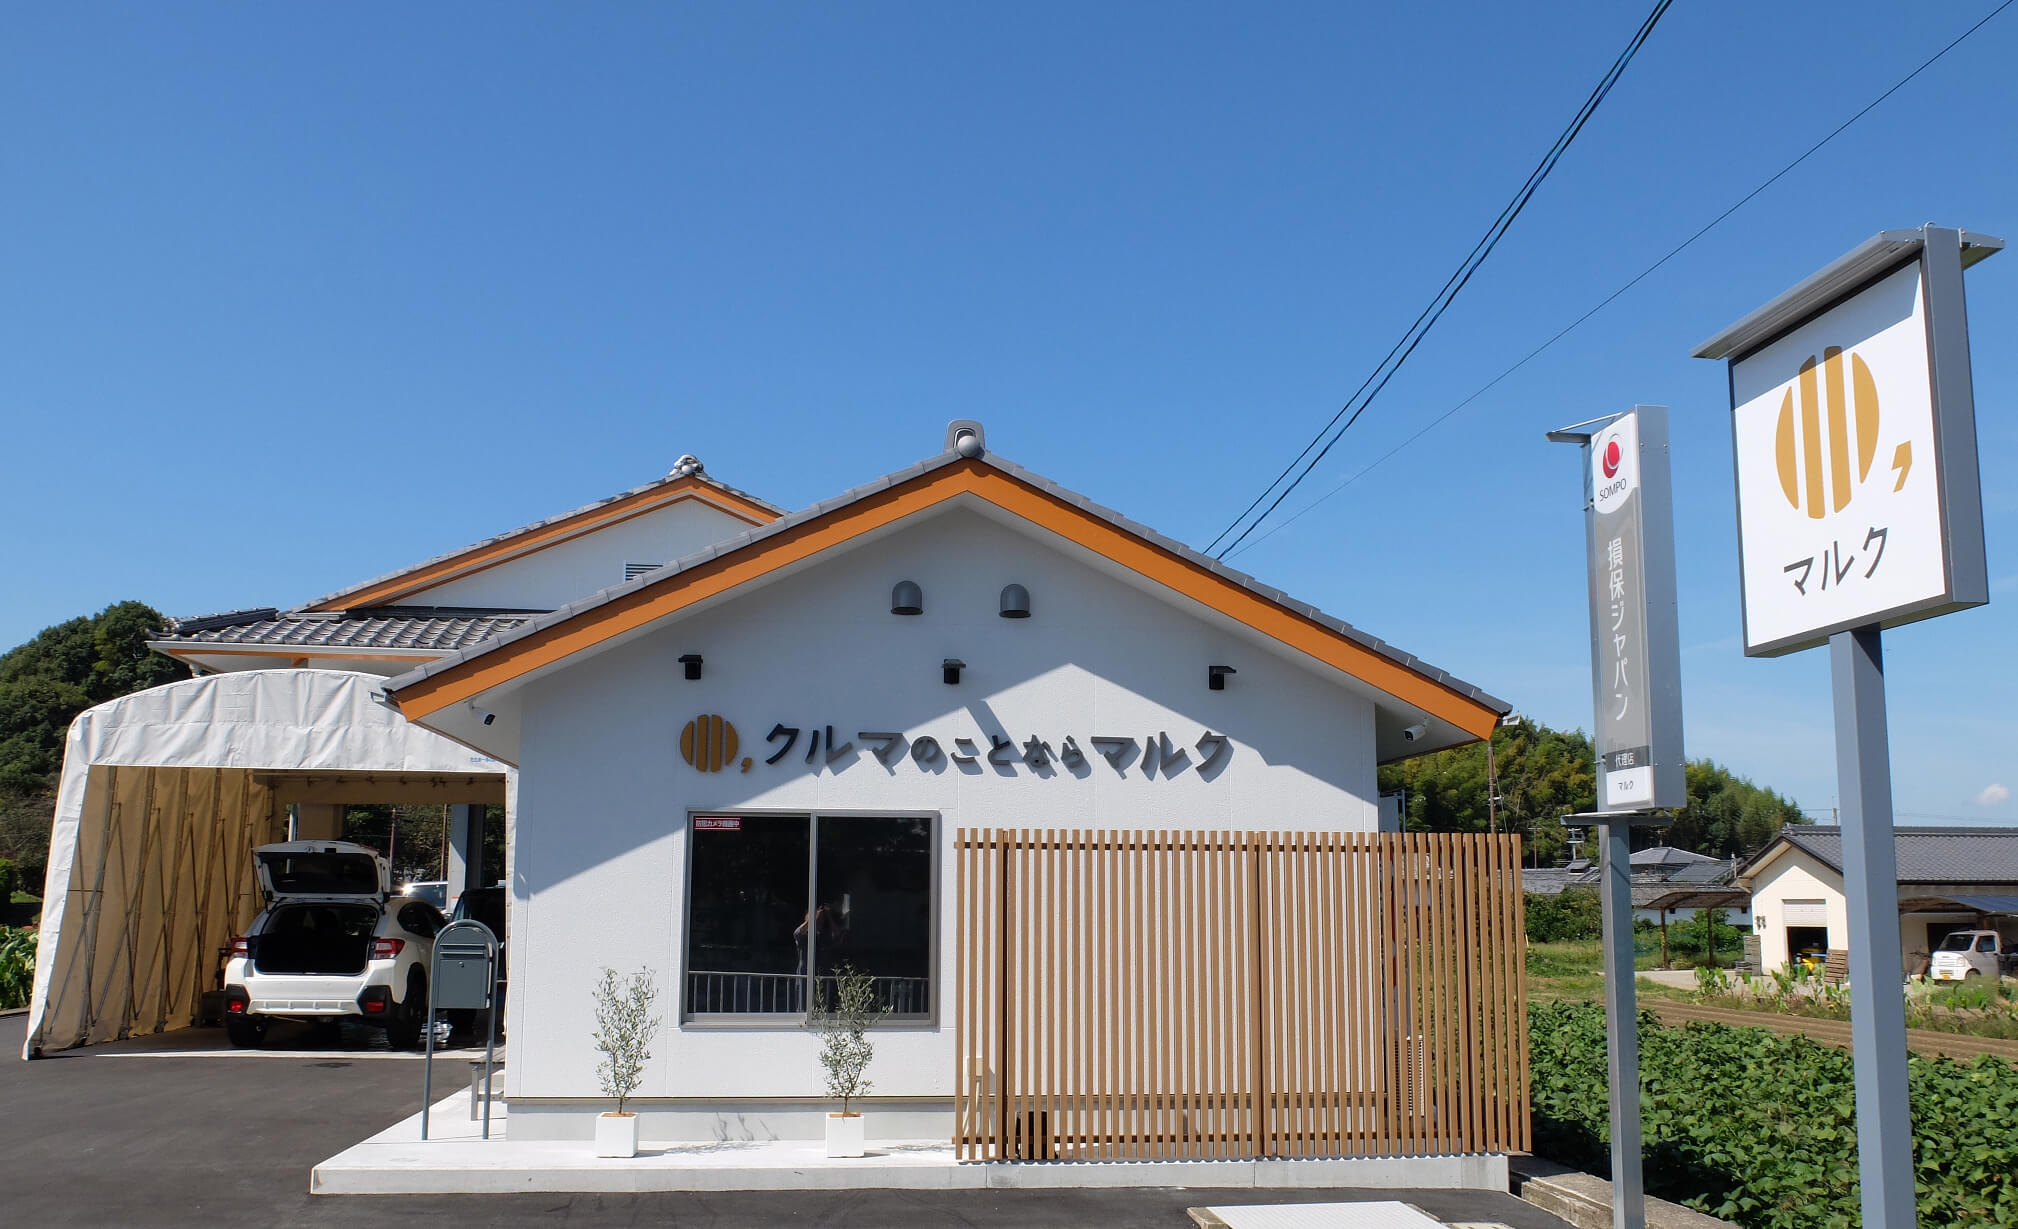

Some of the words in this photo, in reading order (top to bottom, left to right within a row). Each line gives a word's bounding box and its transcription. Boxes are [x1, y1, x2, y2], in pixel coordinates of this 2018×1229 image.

[1600, 479, 1627, 501] SOMPO
[1783, 526, 1888, 596] マルク
[1608, 537, 1627, 719] 損保ジャパン
[1615, 752, 1635, 768] 代理店
[1617, 781, 1634, 791] マルク
